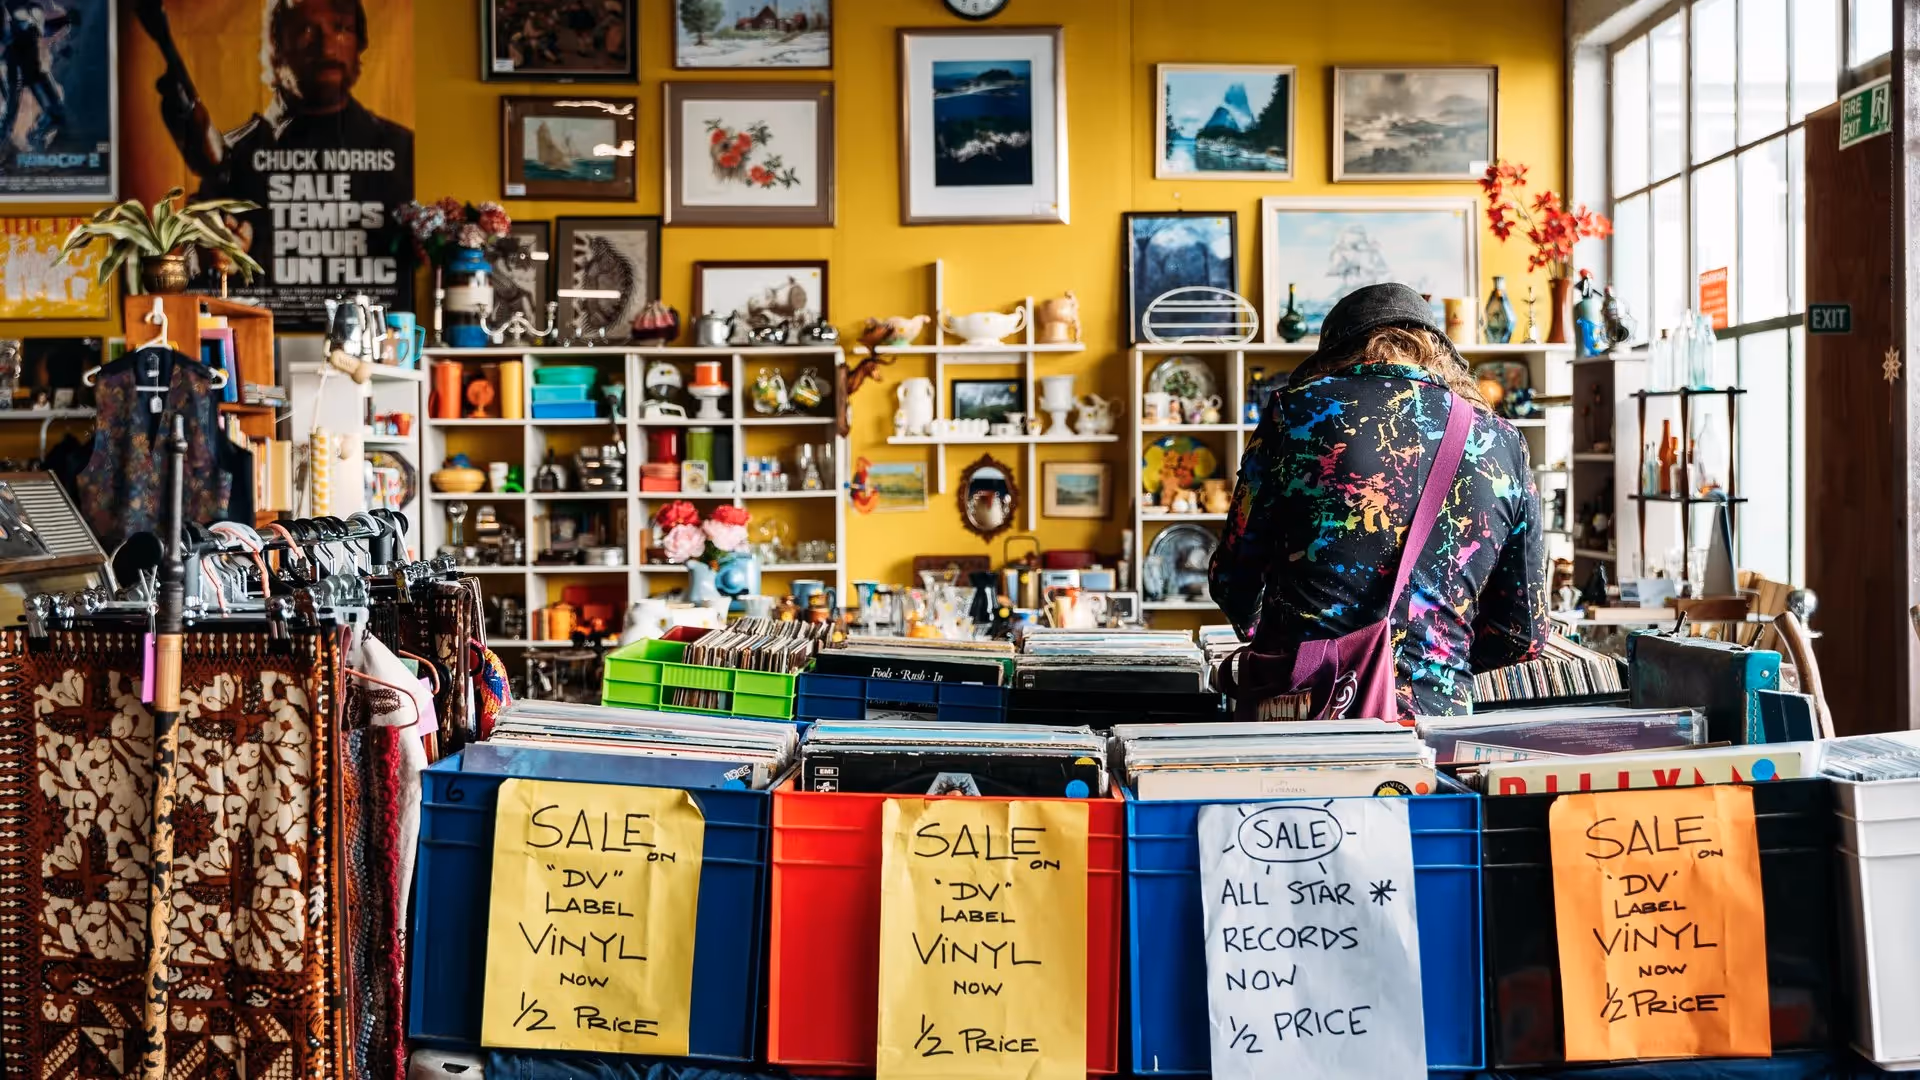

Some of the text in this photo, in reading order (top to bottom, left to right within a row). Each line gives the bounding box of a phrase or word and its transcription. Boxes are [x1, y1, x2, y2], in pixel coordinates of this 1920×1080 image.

[1843, 95, 1863, 119] FIRE
[1842, 118, 1861, 141] EXIT
[253, 150, 396, 171] CHUCK NORRIS
[268, 174, 351, 200] SALE
[269, 202, 384, 228] TEMPS
[274, 230, 368, 256] POUR
[274, 257, 397, 284] UN FLIC
[1812, 308, 1847, 329] EXIT
[871, 667, 944, 682] Fools Rush In
[526, 805, 656, 851] SALE
[1253, 820, 1326, 849] SALE
[1586, 816, 1711, 859] SALE
[914, 823, 1046, 860] SALE
[1698, 849, 1723, 858] ON
[647, 852, 676, 862] ON
[1030, 860, 1060, 870] ON
[546, 892, 634, 917] LABEL
[1221, 879, 1355, 906] ALL STAR
[941, 905, 1015, 923] LABEL
[1615, 900, 1686, 918] LABEL
[1223, 926, 1358, 952] RECORDS
[560, 973, 609, 987] NOW
[1226, 964, 1296, 990] NOW
[1639, 964, 1687, 978] NOW
[954, 981, 1003, 996] NOW
[1274, 1006, 1371, 1040] PRICE
